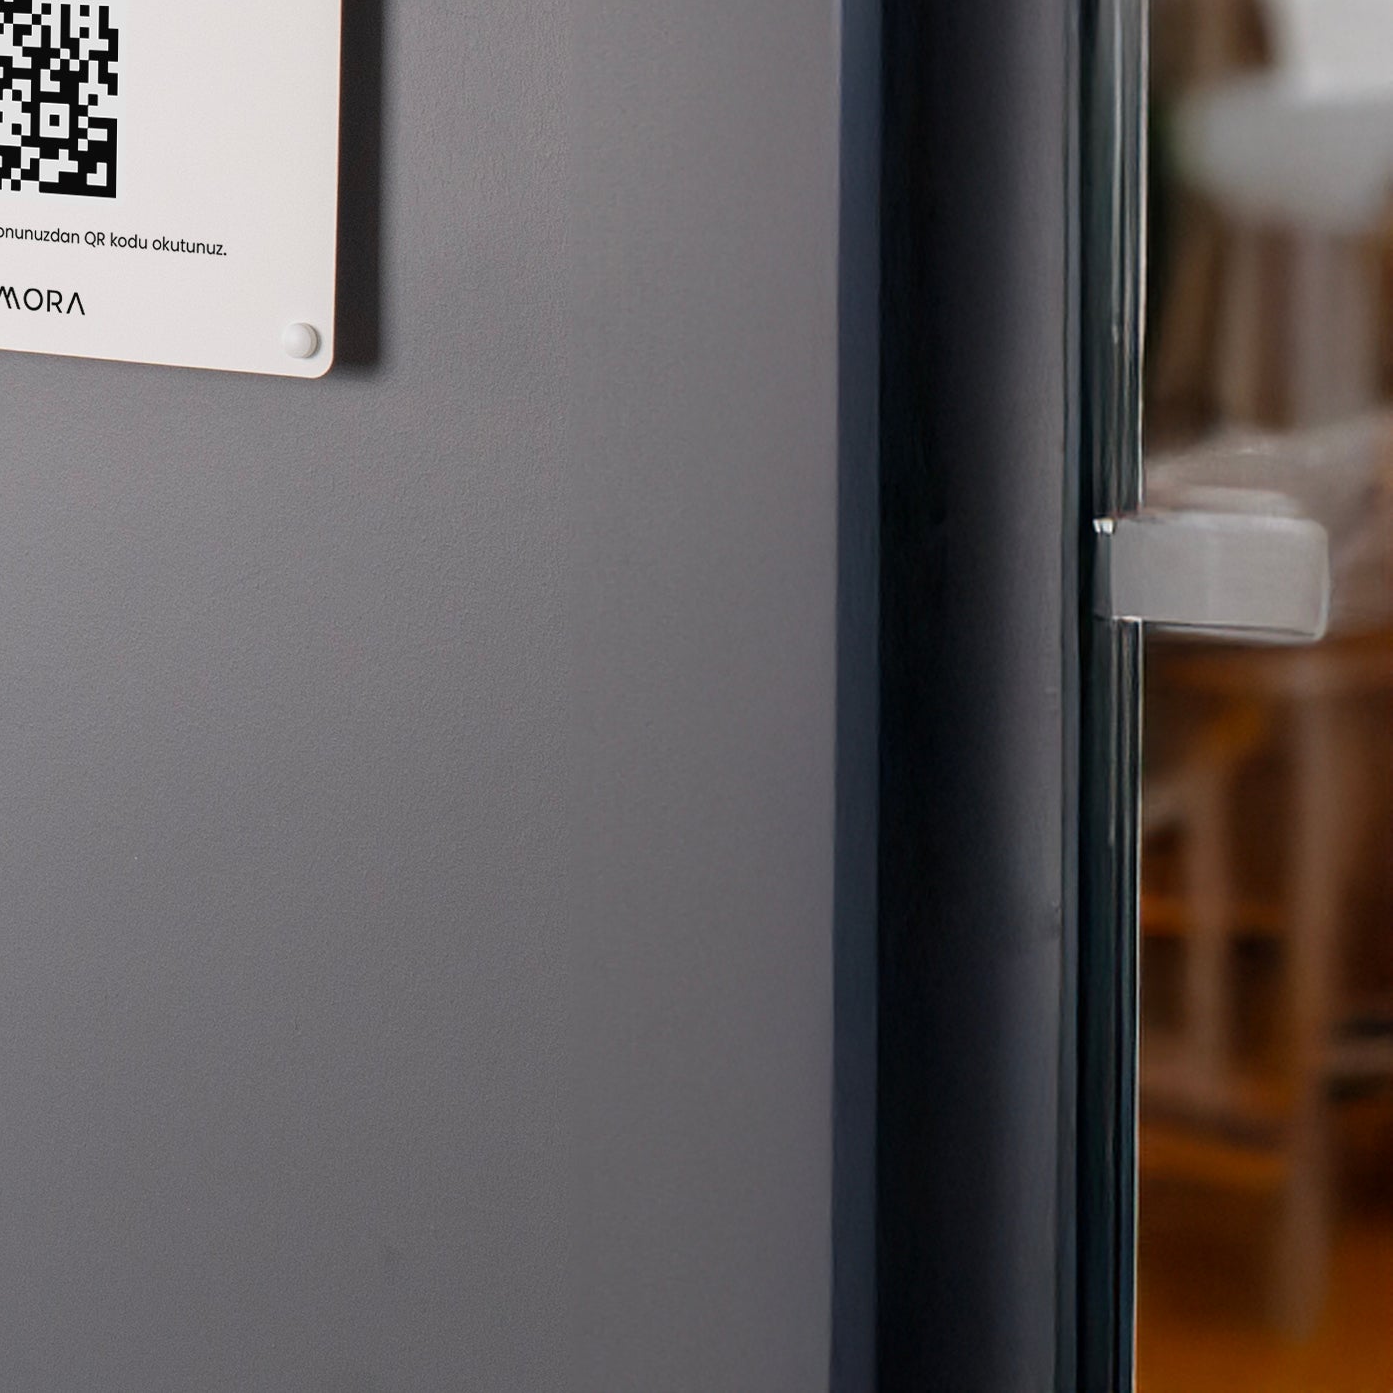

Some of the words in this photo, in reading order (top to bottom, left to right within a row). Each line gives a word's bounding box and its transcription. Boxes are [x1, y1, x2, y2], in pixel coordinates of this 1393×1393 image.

[83, 230, 106, 249] QR
[110, 231, 148, 250] kodu
[151, 235, 228, 257] okutunuz.
